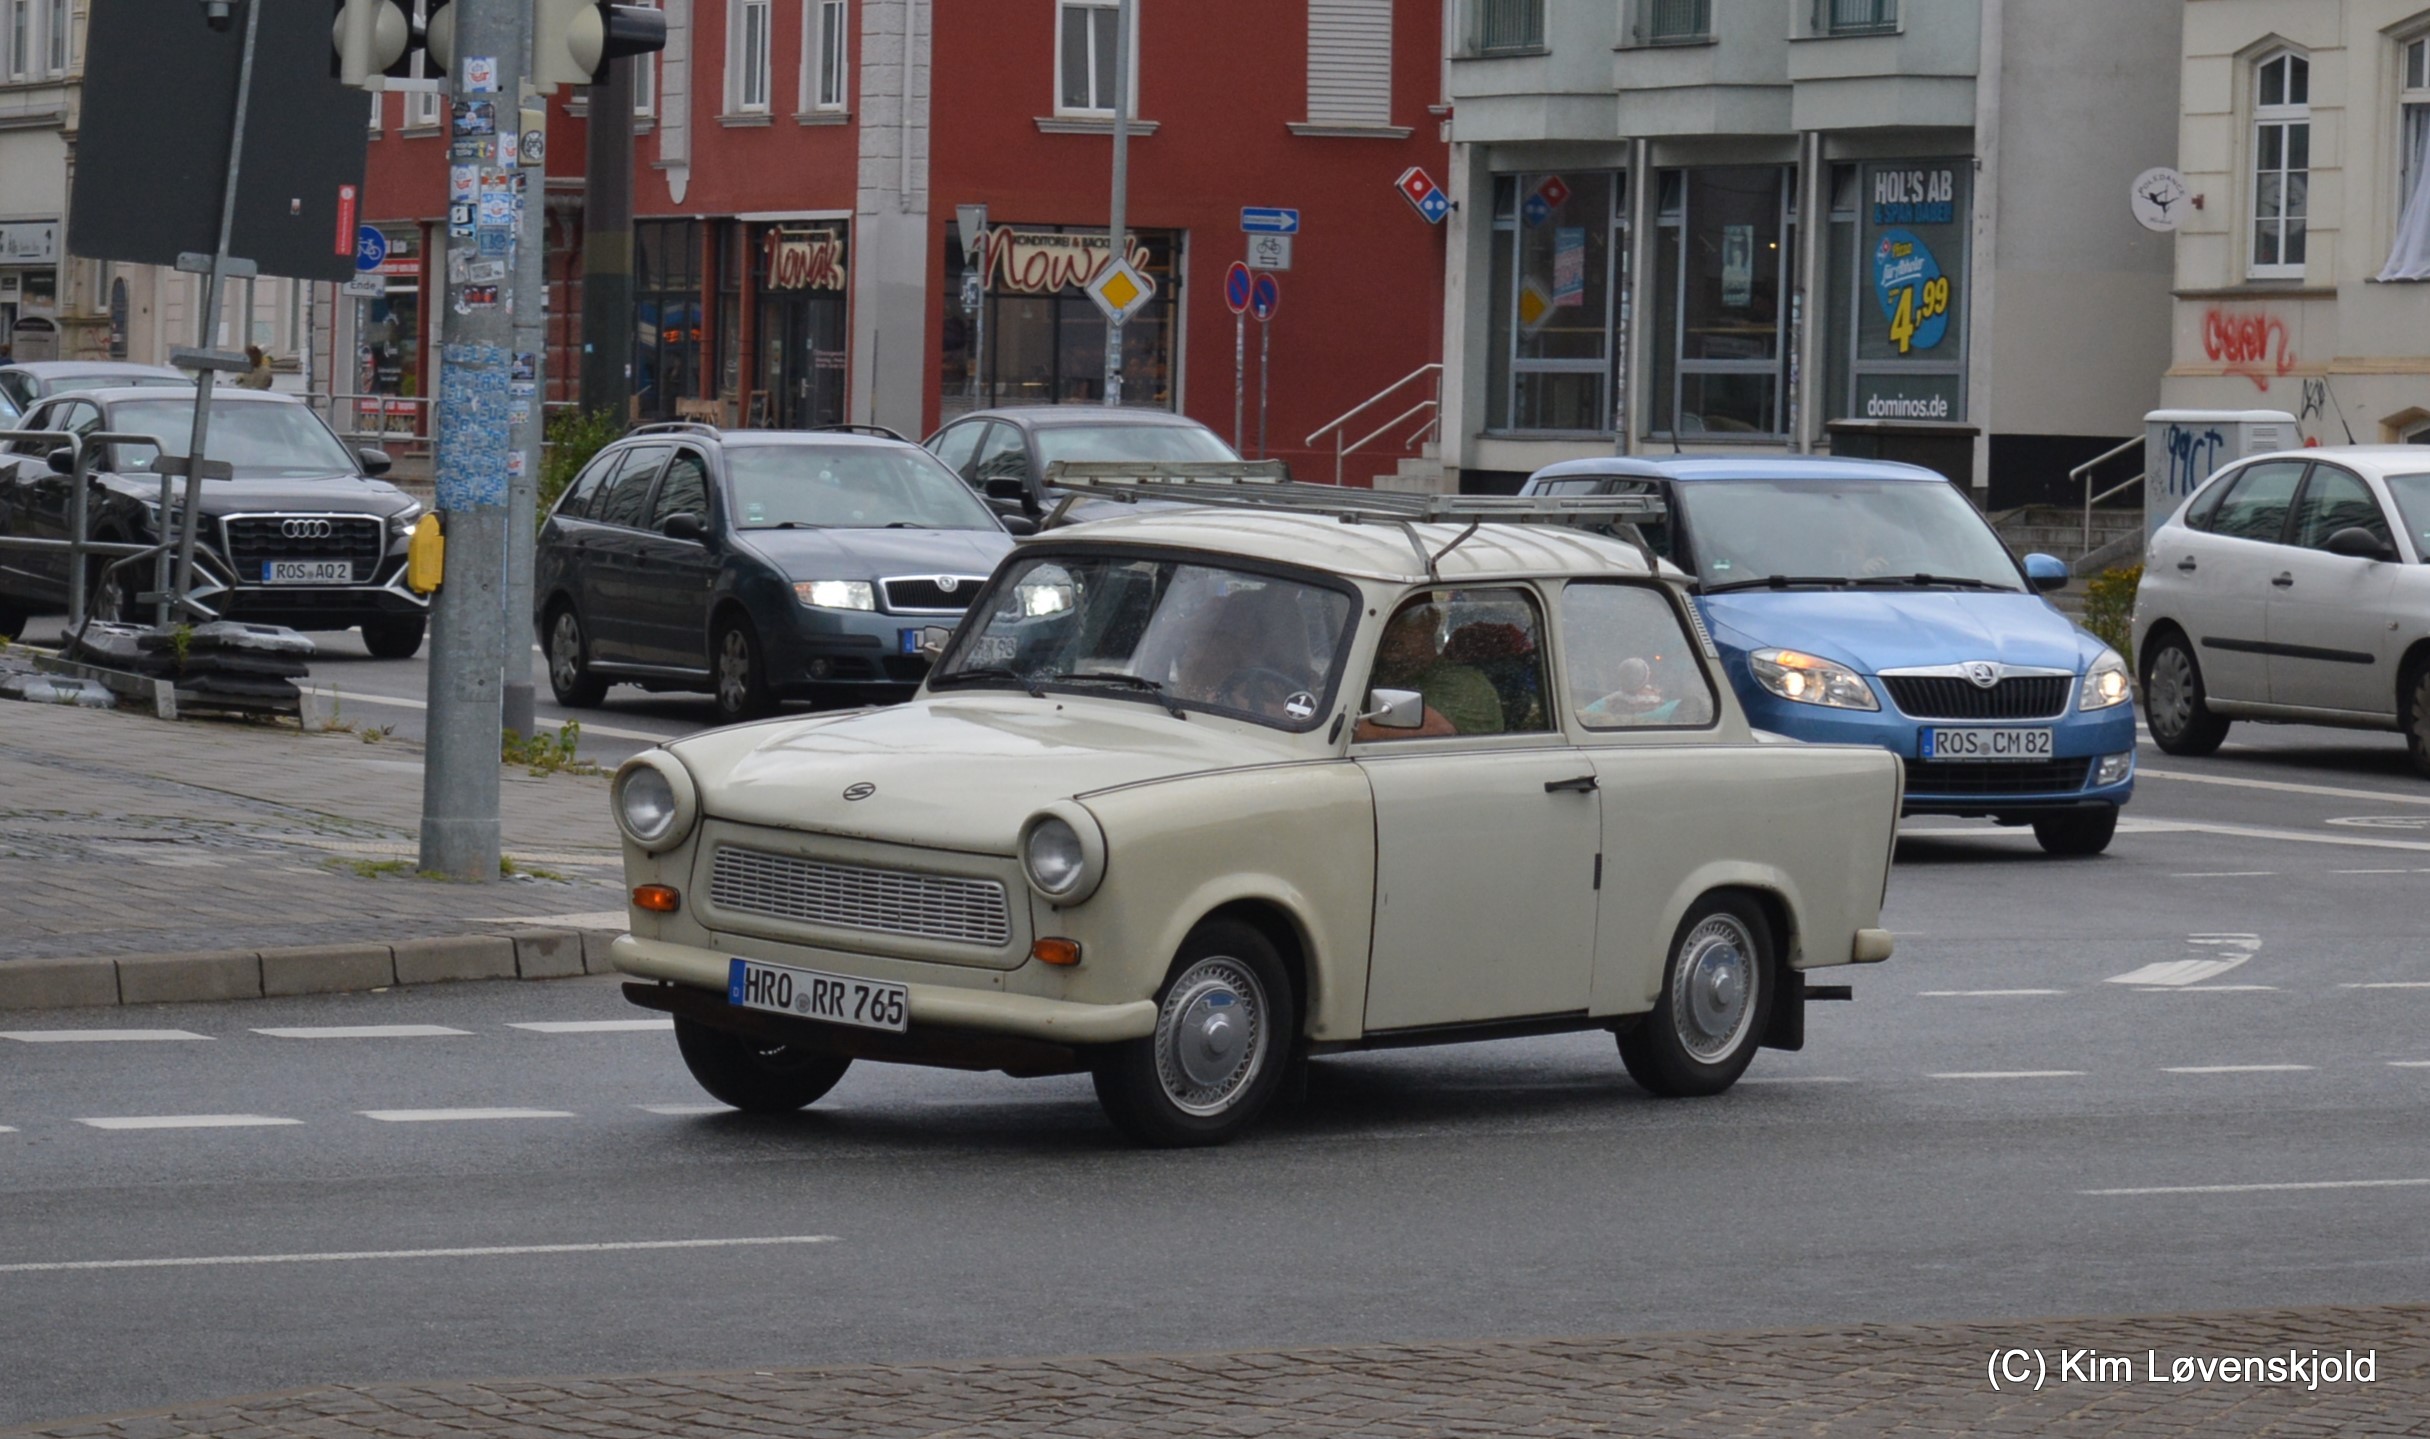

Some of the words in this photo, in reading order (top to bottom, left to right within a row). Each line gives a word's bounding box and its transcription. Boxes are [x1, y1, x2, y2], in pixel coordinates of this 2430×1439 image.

[1875, 171, 1924, 204] HOL'S
[1927, 170, 1952, 202] AB
[972, 226, 1156, 292] Nowk
[351, 280, 377, 291] Ende
[1867, 393, 1948, 417] dominos.de
[276, 564, 305, 579] ROS
[315, 564, 334, 579] AQ
[338, 564, 346, 579] 2
[1935, 732, 1978, 754] ROS
[1993, 732, 2020, 753] CM
[2025, 732, 2049, 753] 82
[745, 967, 792, 1008] HRO
[812, 978, 845, 1017] RR
[854, 985, 904, 1025] 765
